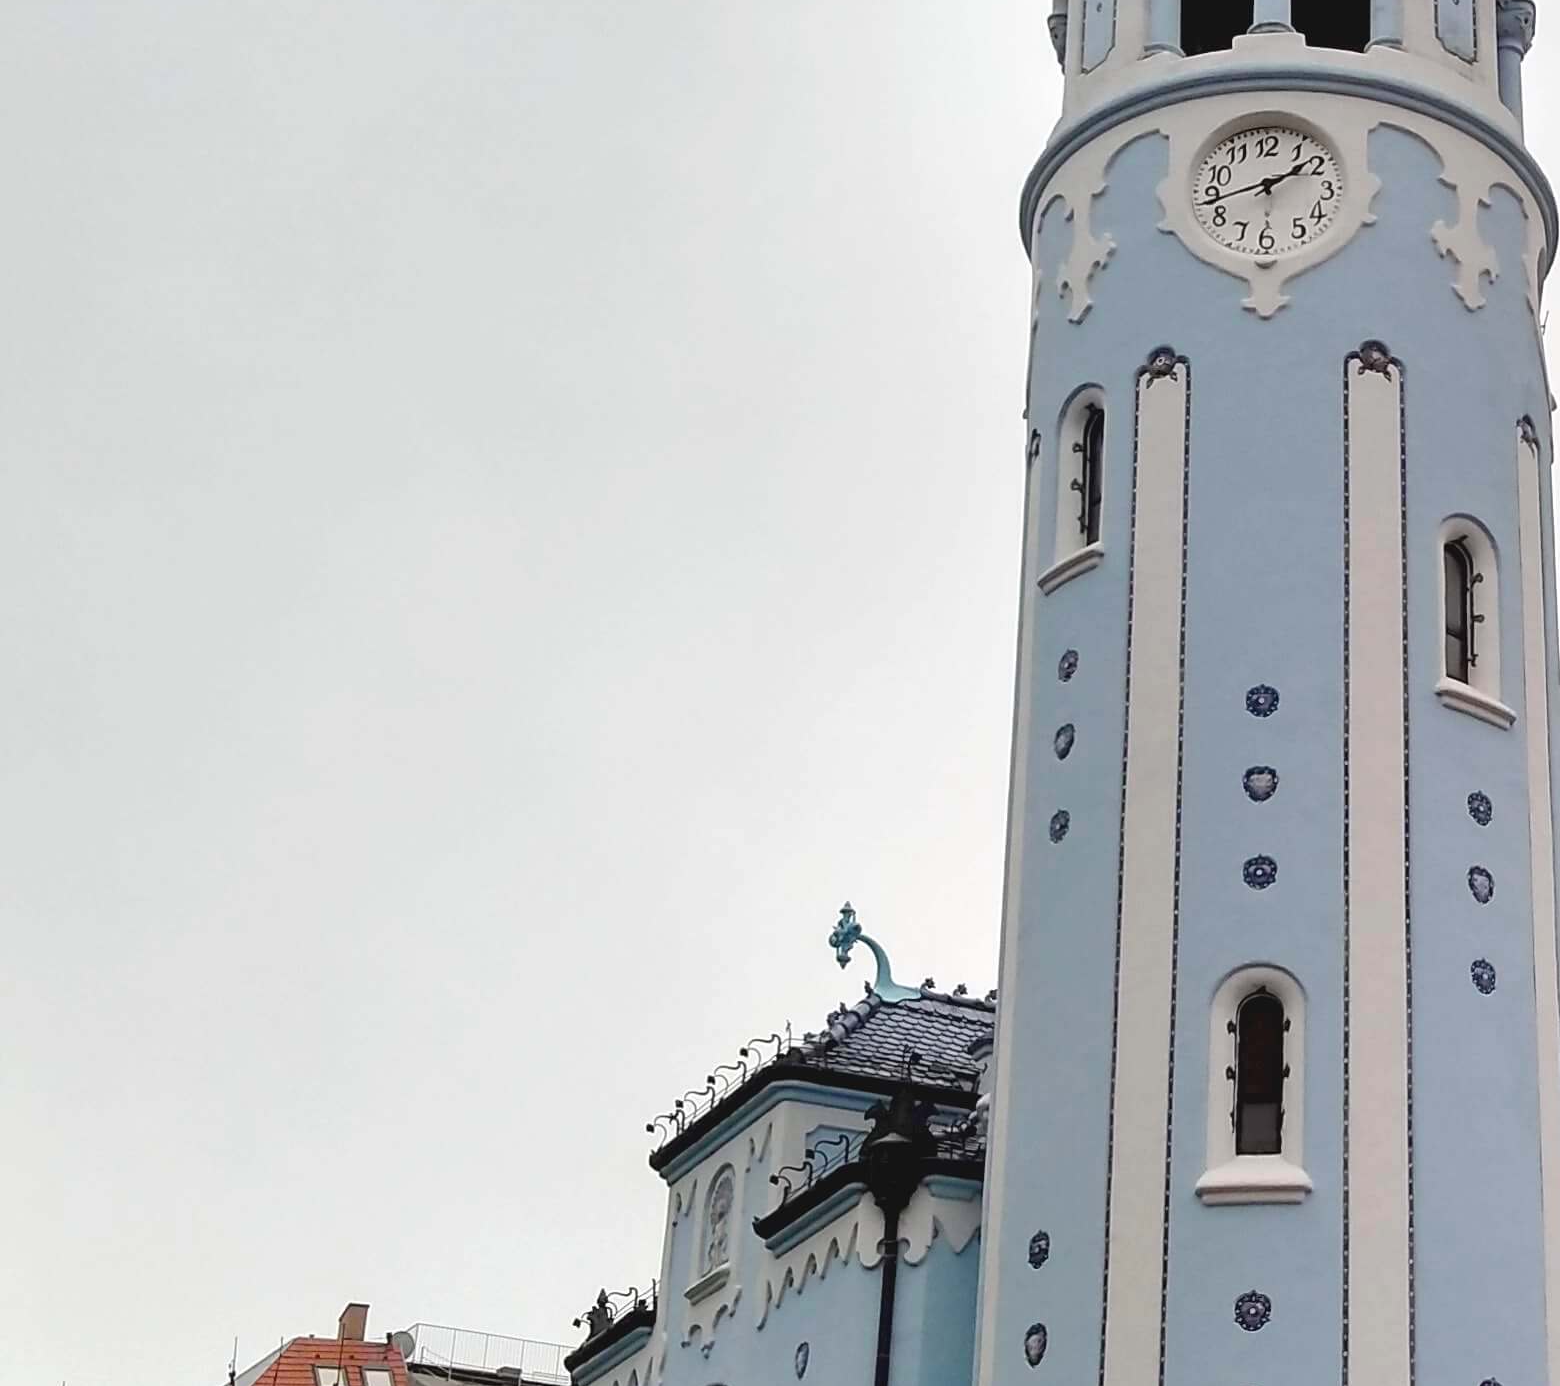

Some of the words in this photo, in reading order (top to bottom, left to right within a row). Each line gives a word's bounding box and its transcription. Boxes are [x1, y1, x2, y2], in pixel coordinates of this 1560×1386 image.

[1226, 144, 1247, 164] 11
[1255, 136, 1279, 158] 12
[1291, 143, 1303, 162] 1
[1310, 155, 1325, 175] 2
[1208, 165, 1231, 186] 10
[1204, 186, 1220, 204] 9
[1320, 180, 1335, 200] 3
[1212, 205, 1226, 227] 8
[1309, 200, 1327, 226] 4
[1233, 221, 1250, 241] 7
[1258, 224, 1275, 250] 6
[1291, 217, 1306, 239] 5
